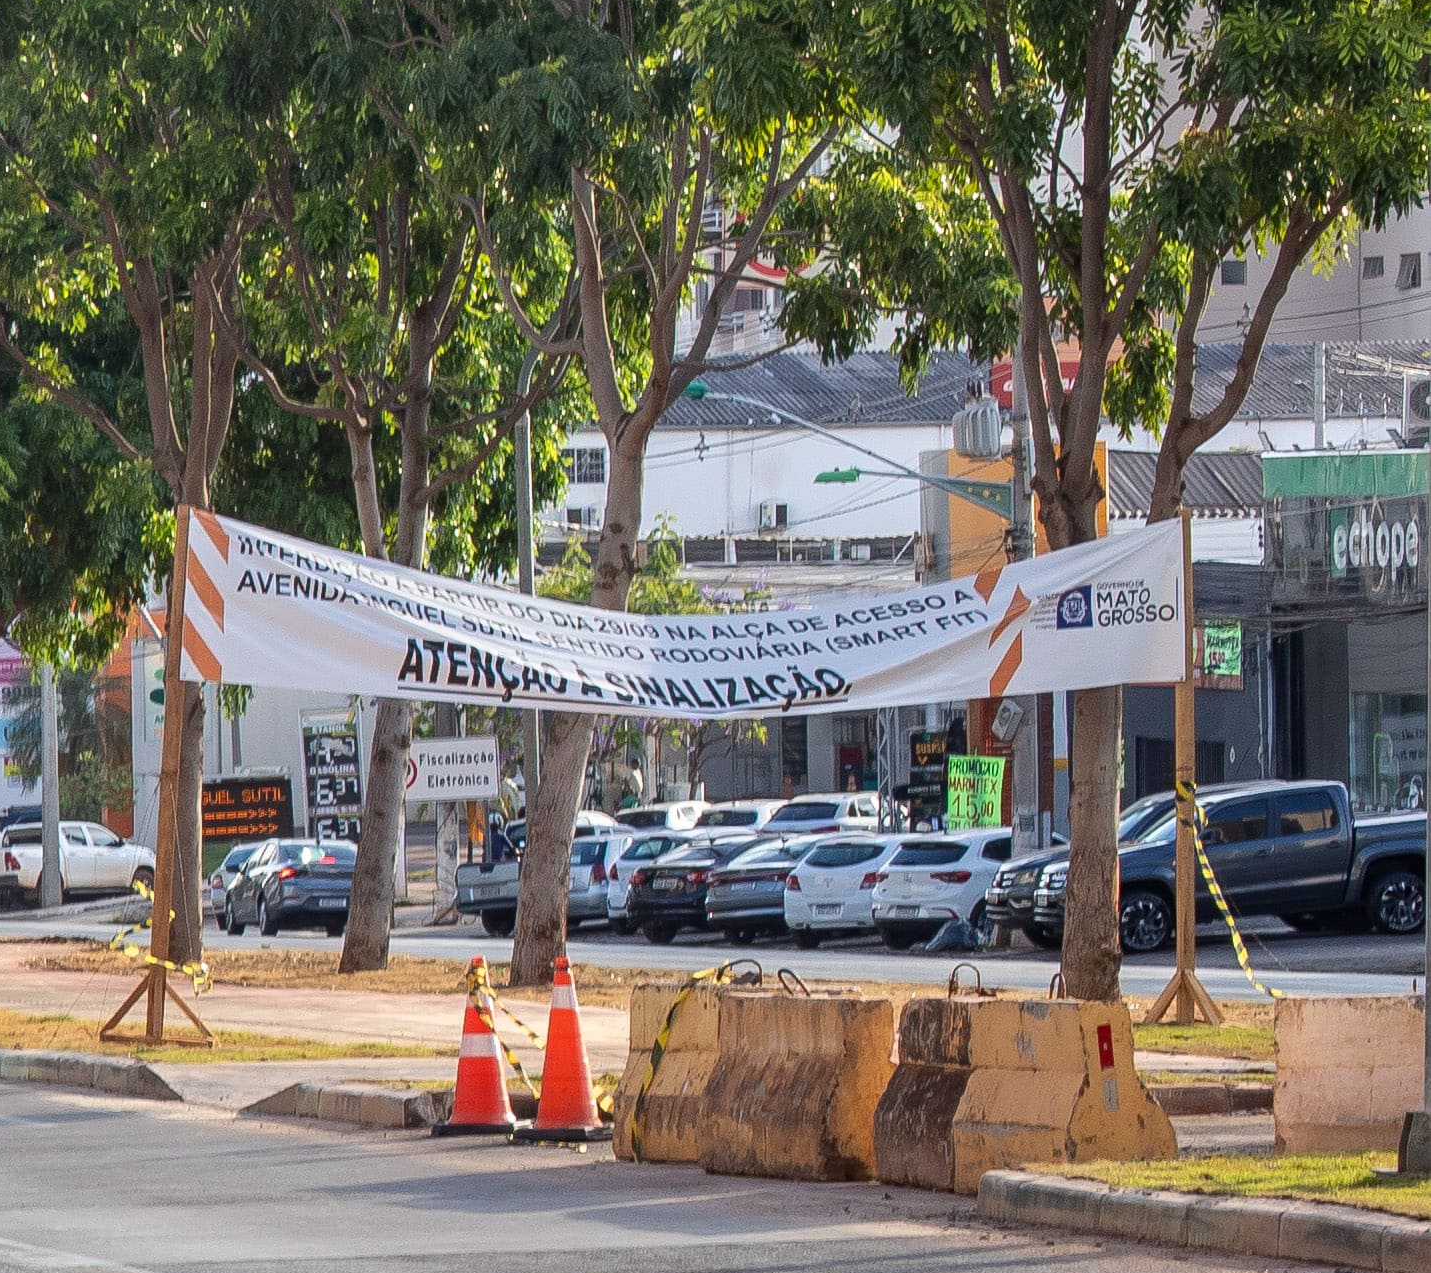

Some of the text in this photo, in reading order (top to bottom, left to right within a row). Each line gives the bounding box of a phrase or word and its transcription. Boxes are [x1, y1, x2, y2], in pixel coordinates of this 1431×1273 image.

[1333, 508, 1419, 586] echope
[1097, 579, 1145, 590] GOVERNO DE
[1097, 588, 1151, 609] MATO
[237, 569, 360, 606] AVENIDA
[461, 614, 534, 644] SUTIL
[535, 630, 645, 661] SENTIDO
[650, 636, 821, 665] RODOVIÁRIA
[825, 620, 928, 655] (SMART
[935, 609, 989, 632] FIT)
[417, 584, 501, 614] PARTIR
[507, 601, 545, 624] DO
[549, 608, 595, 630] DIA
[593, 617, 660, 640] 29/09
[664, 625, 706, 642] NA
[712, 621, 784, 642] ALÇA
[787, 616, 829, 634] DE
[835, 594, 947, 629] ACESSO
[954, 589, 975, 605] A
[1098, 604, 1175, 627] GROSSO
[397, 638, 569, 703] ATENÇÃO
[419, 750, 495, 767] Fiscalização
[427, 773, 490, 788] Eletrônica
[949, 776, 999, 795] MARMITEX
[241, 786, 287, 803] SUTIL
